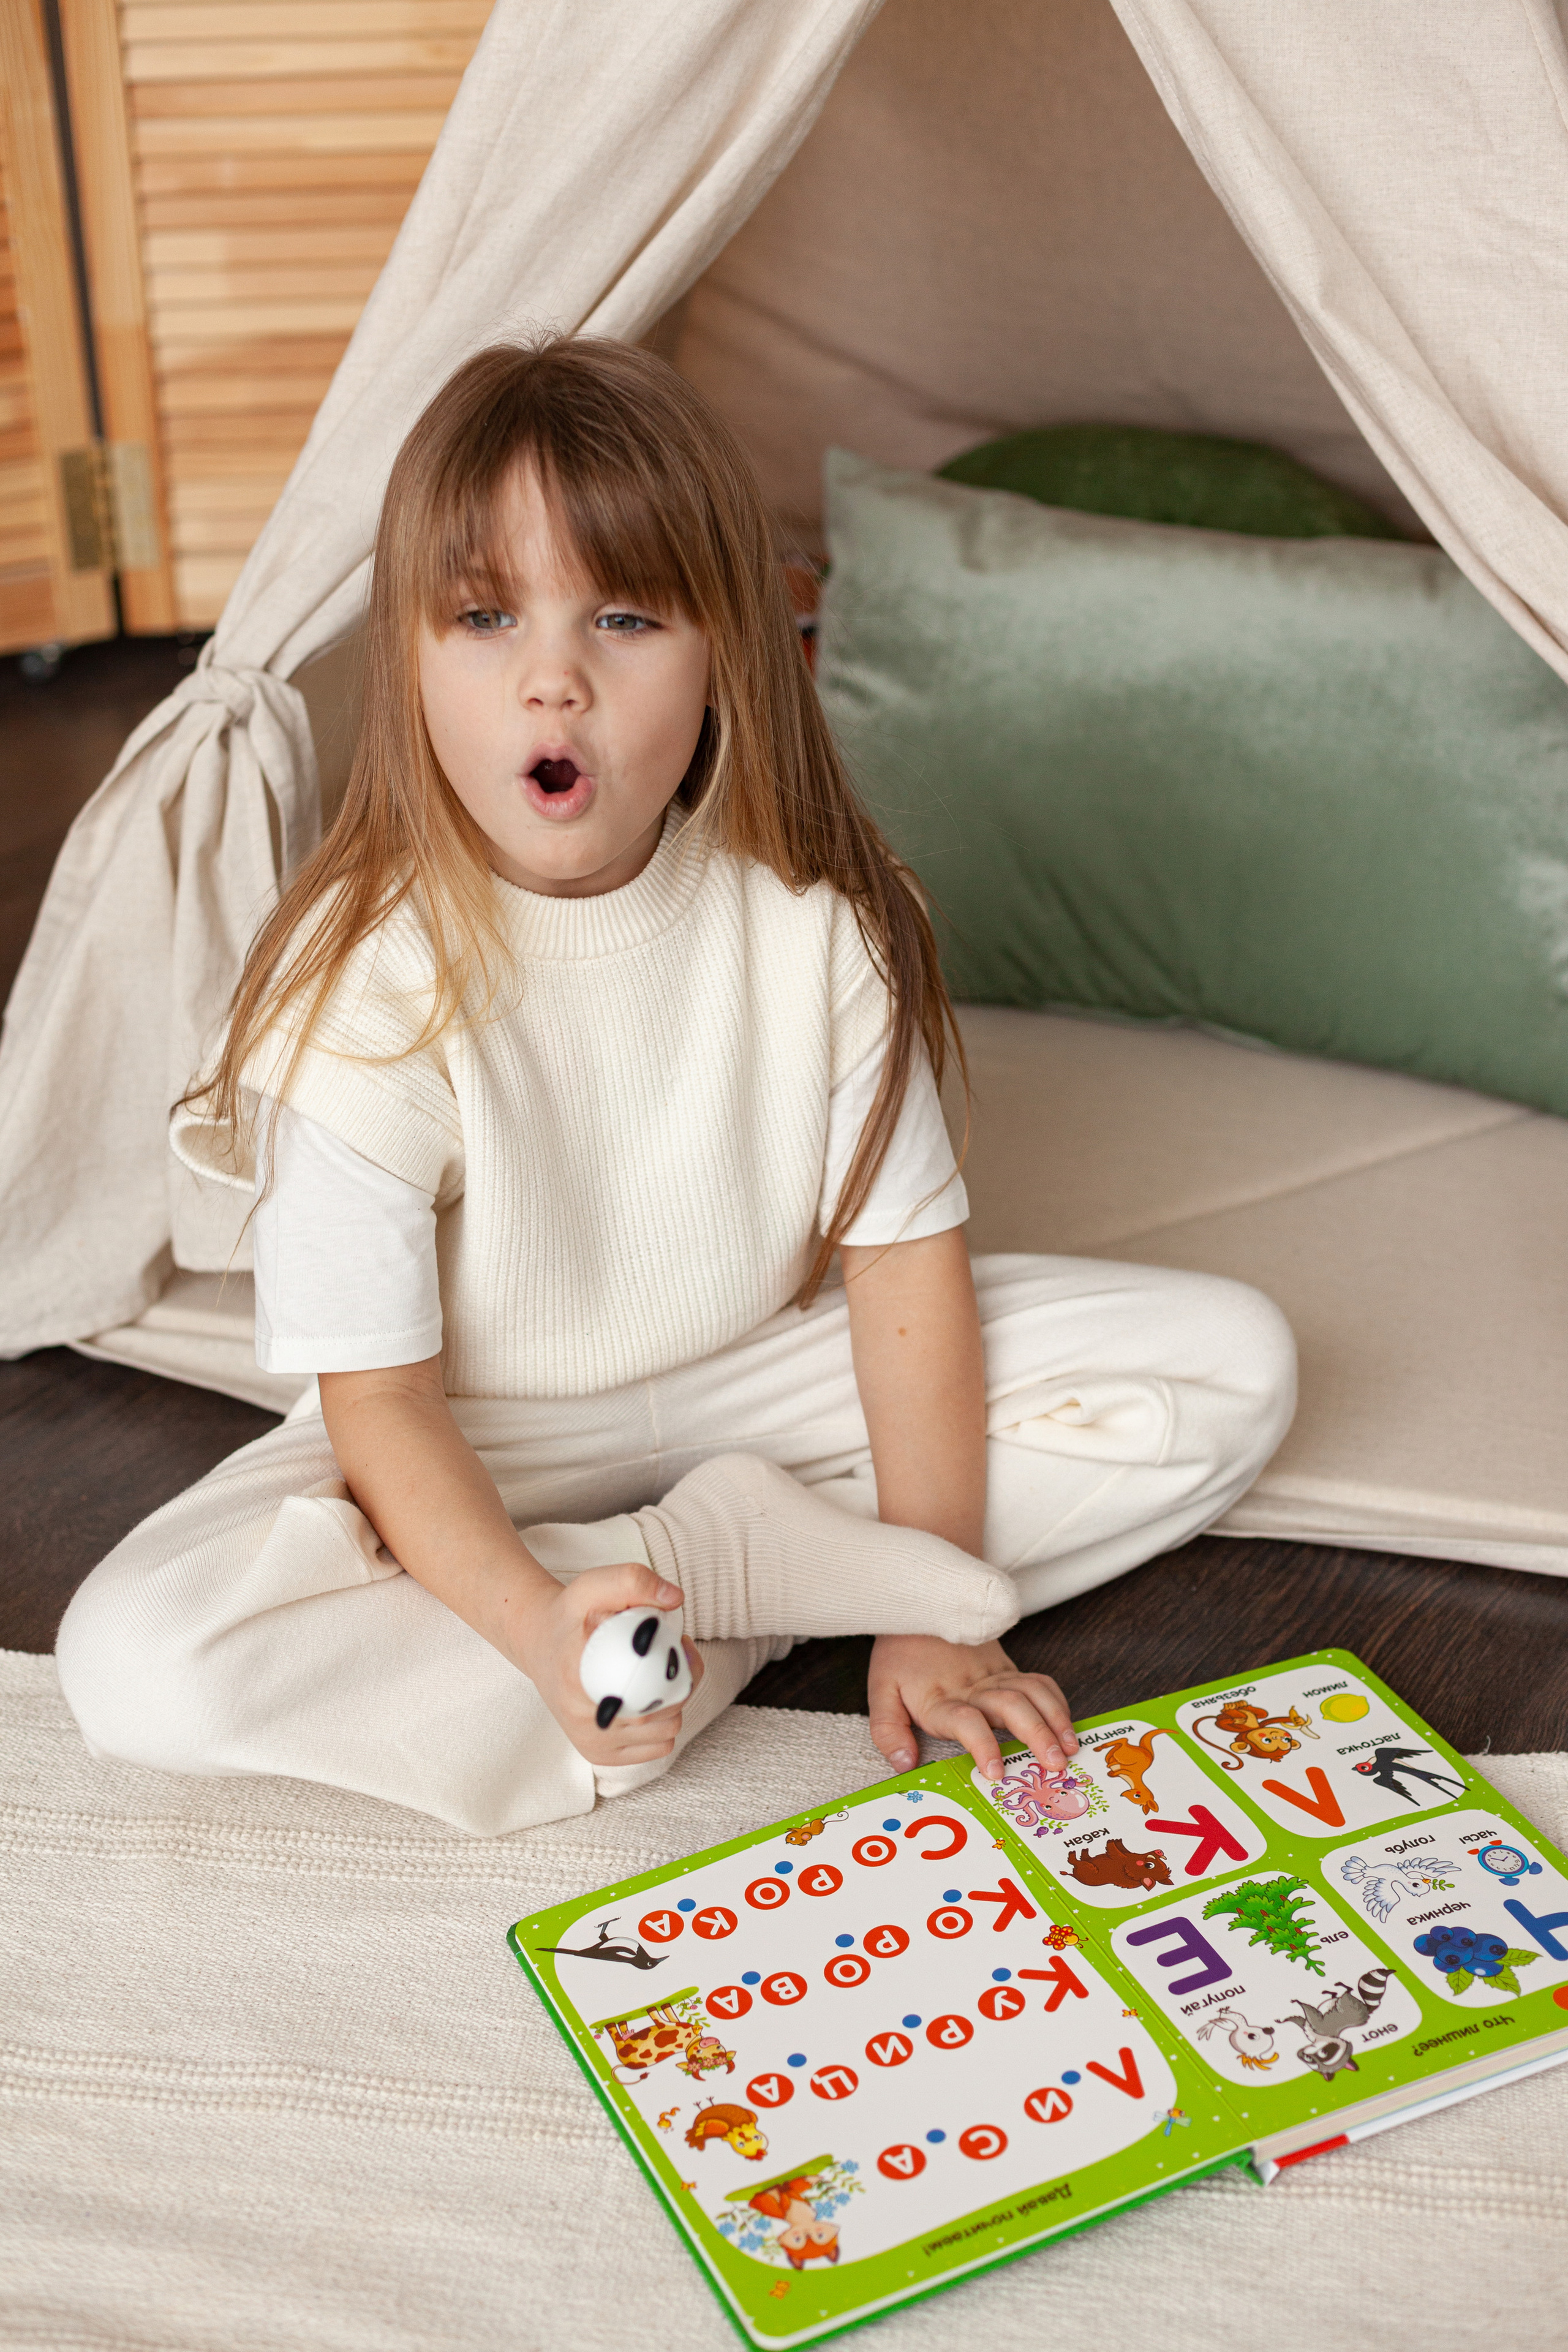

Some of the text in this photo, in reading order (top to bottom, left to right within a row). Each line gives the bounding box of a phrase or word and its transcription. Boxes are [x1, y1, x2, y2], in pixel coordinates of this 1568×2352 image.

[1191, 1686, 1257, 1709] обезьяна
[1302, 1681, 1349, 1698] лимон
[1079, 1725, 1135, 1747] кенгуру
[1336, 1732, 1401, 1755] ласточка
[1262, 1766, 1346, 1827] Л
[1063, 1827, 1110, 1849] кабан
[1145, 1804, 1249, 1875] К
[1384, 1834, 1436, 1855] голубь
[1459, 1829, 1498, 1845] часы
[1406, 1901, 1472, 1926] черника
[1319, 1931, 1349, 1944] ель
[1126, 1917, 1232, 1995] Е
[1180, 1985, 1246, 2016] попугай
[1361, 2023, 1398, 2043] енот
[1413, 2015, 1516, 2057] Что лишнее?
[922, 2182, 1072, 2258] Давай почитаем!
